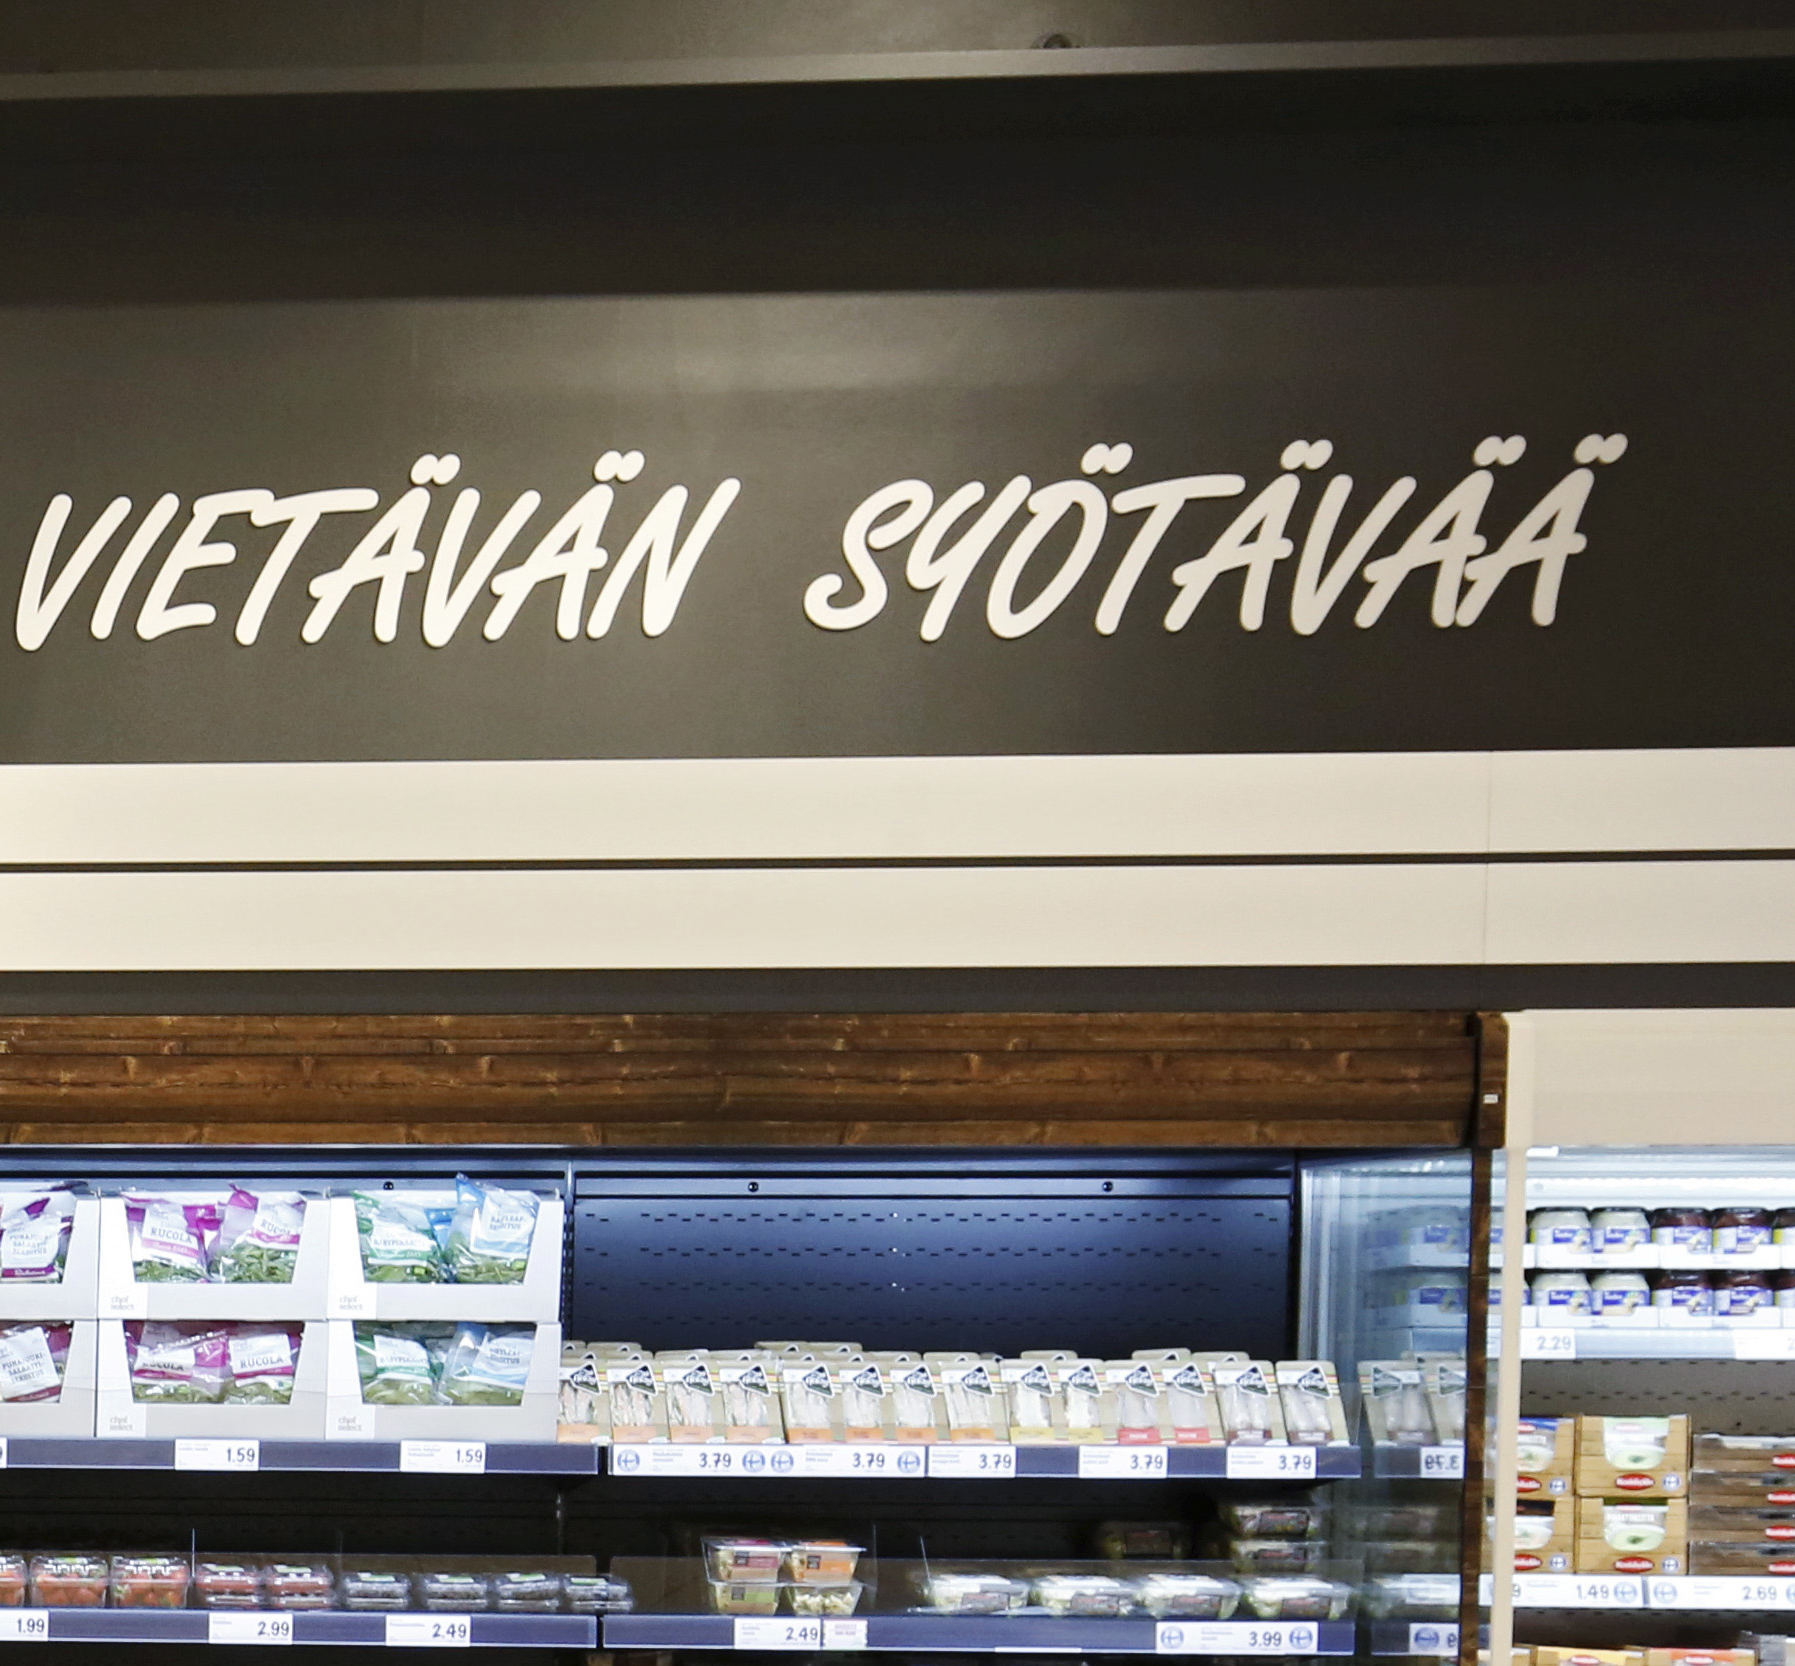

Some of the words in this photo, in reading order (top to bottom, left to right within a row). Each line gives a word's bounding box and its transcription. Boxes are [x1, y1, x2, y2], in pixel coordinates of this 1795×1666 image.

[15, 451, 741, 651] VIETÄVÄN
[803, 434, 1631, 641] SYÖTÄVÄÄ
[150, 1227, 192, 1244] RUCOLA
[240, 1356, 284, 1369] RUCOLA
[226, 1448, 255, 1463] 1.59
[455, 1449, 483, 1463] 1.59
[699, 1453, 731, 1469] 3.79
[979, 1454, 1012, 1469] 3.79
[1279, 1455, 1312, 1470] 3.79
[17, 1618, 45, 1633] 1.99
[257, 1621, 290, 1636] 2.99
[785, 1627, 818, 1641] 2.49
[1249, 1633, 1282, 1647] 3.99
